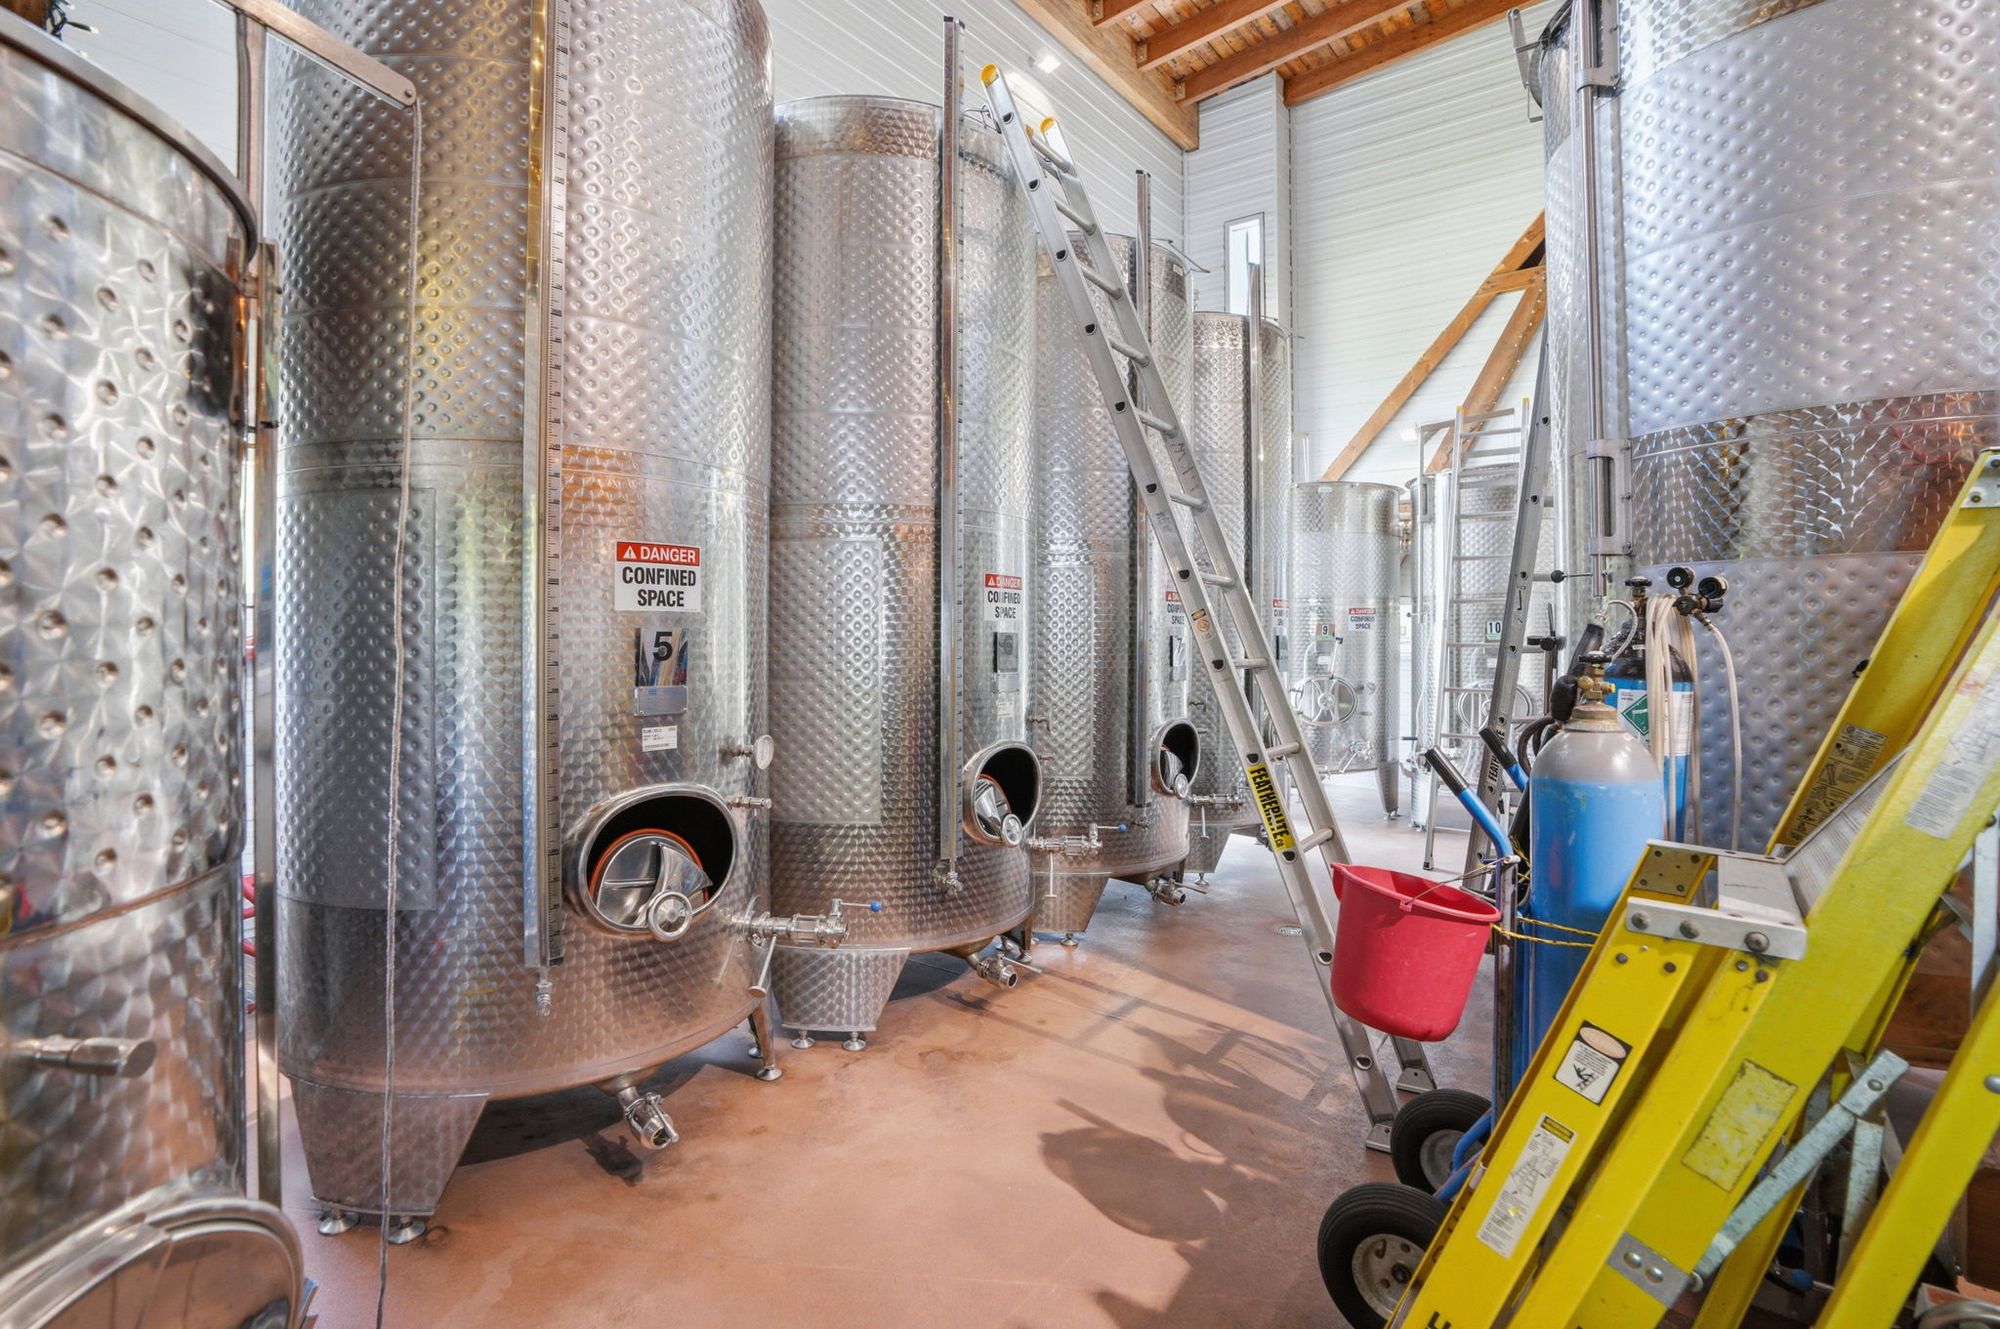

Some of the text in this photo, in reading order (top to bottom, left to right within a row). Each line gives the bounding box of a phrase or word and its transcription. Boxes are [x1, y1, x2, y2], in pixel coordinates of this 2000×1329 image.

[640, 546, 697, 564] DANGER
[622, 566, 697, 587] CONFINED
[996, 576, 1022, 589] DANGER
[637, 589, 685, 607] SPACE
[987, 591, 1021, 604] CONFINED
[995, 606, 1017, 619] SPACE
[1322, 625, 1328, 635] 9
[1489, 622, 1501, 634] 10
[653, 631, 673, 661] 5
